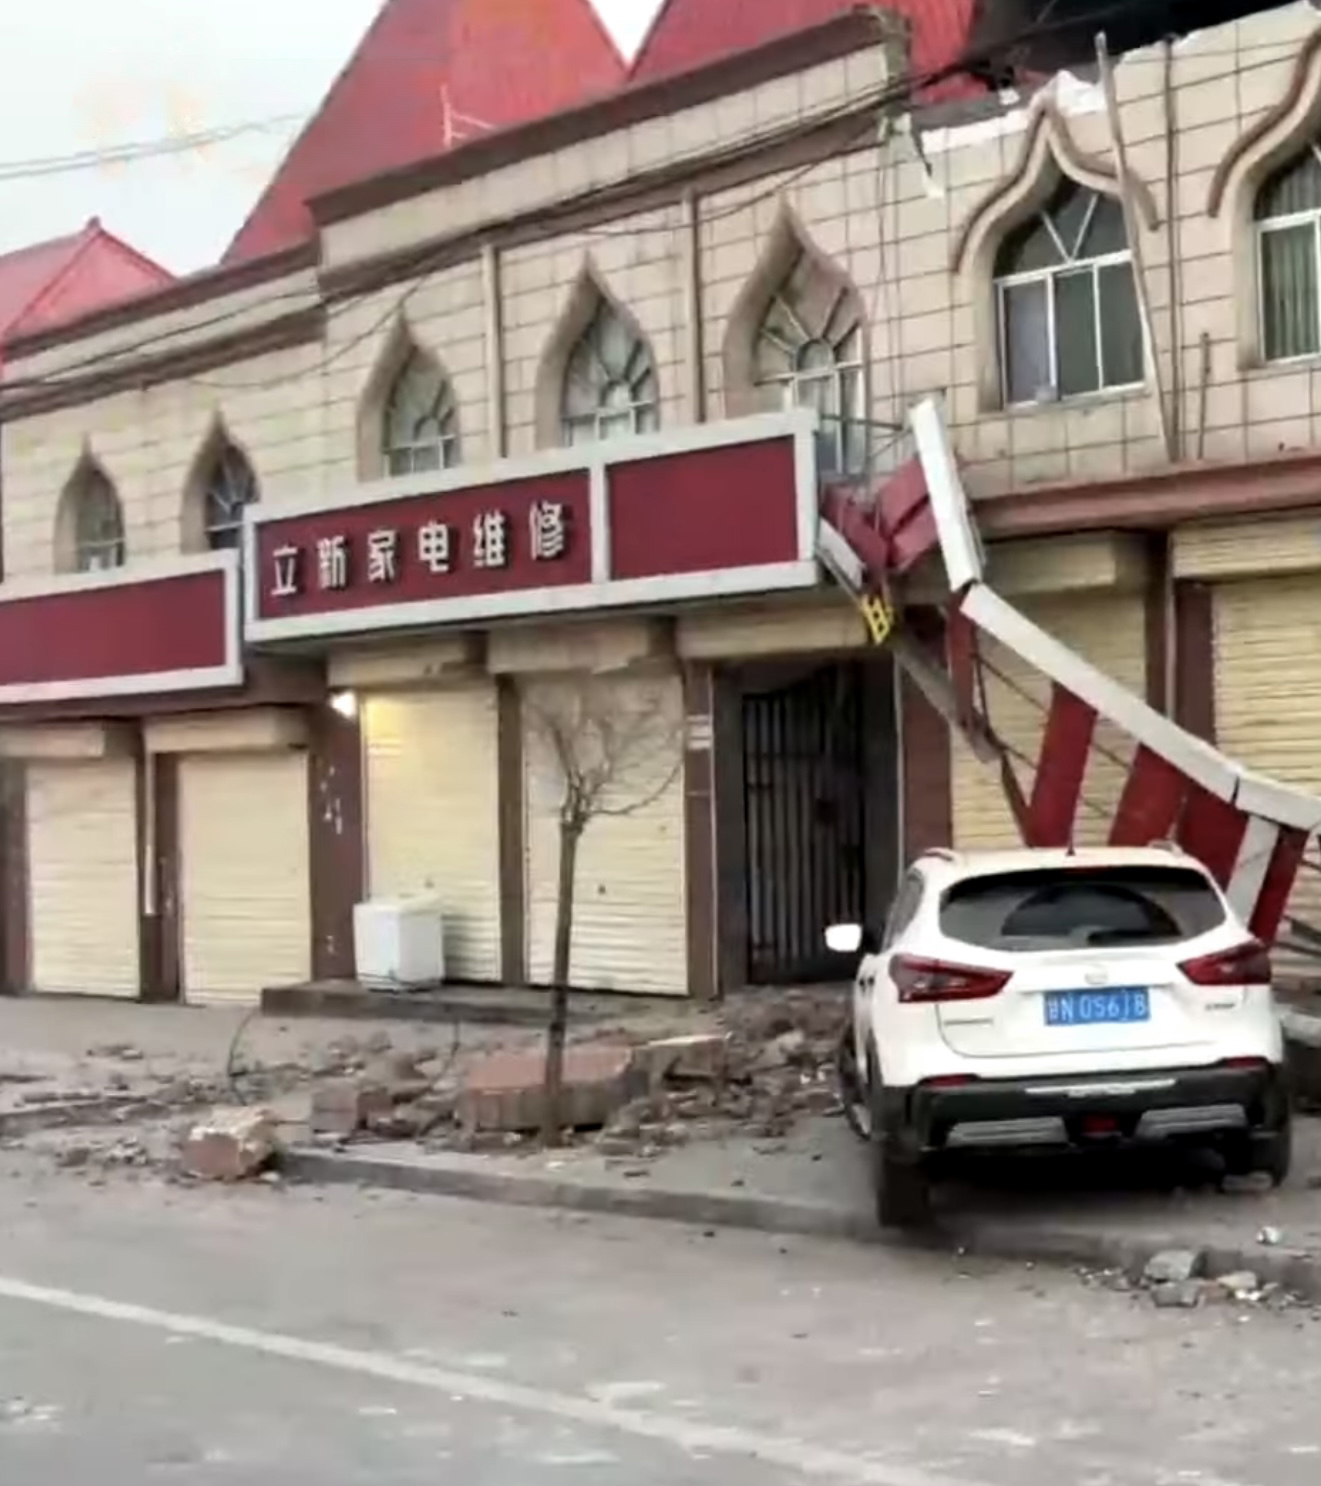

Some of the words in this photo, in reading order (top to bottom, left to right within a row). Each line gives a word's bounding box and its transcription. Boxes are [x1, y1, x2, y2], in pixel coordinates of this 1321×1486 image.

[271, 501, 564, 596] 立新家电维修
